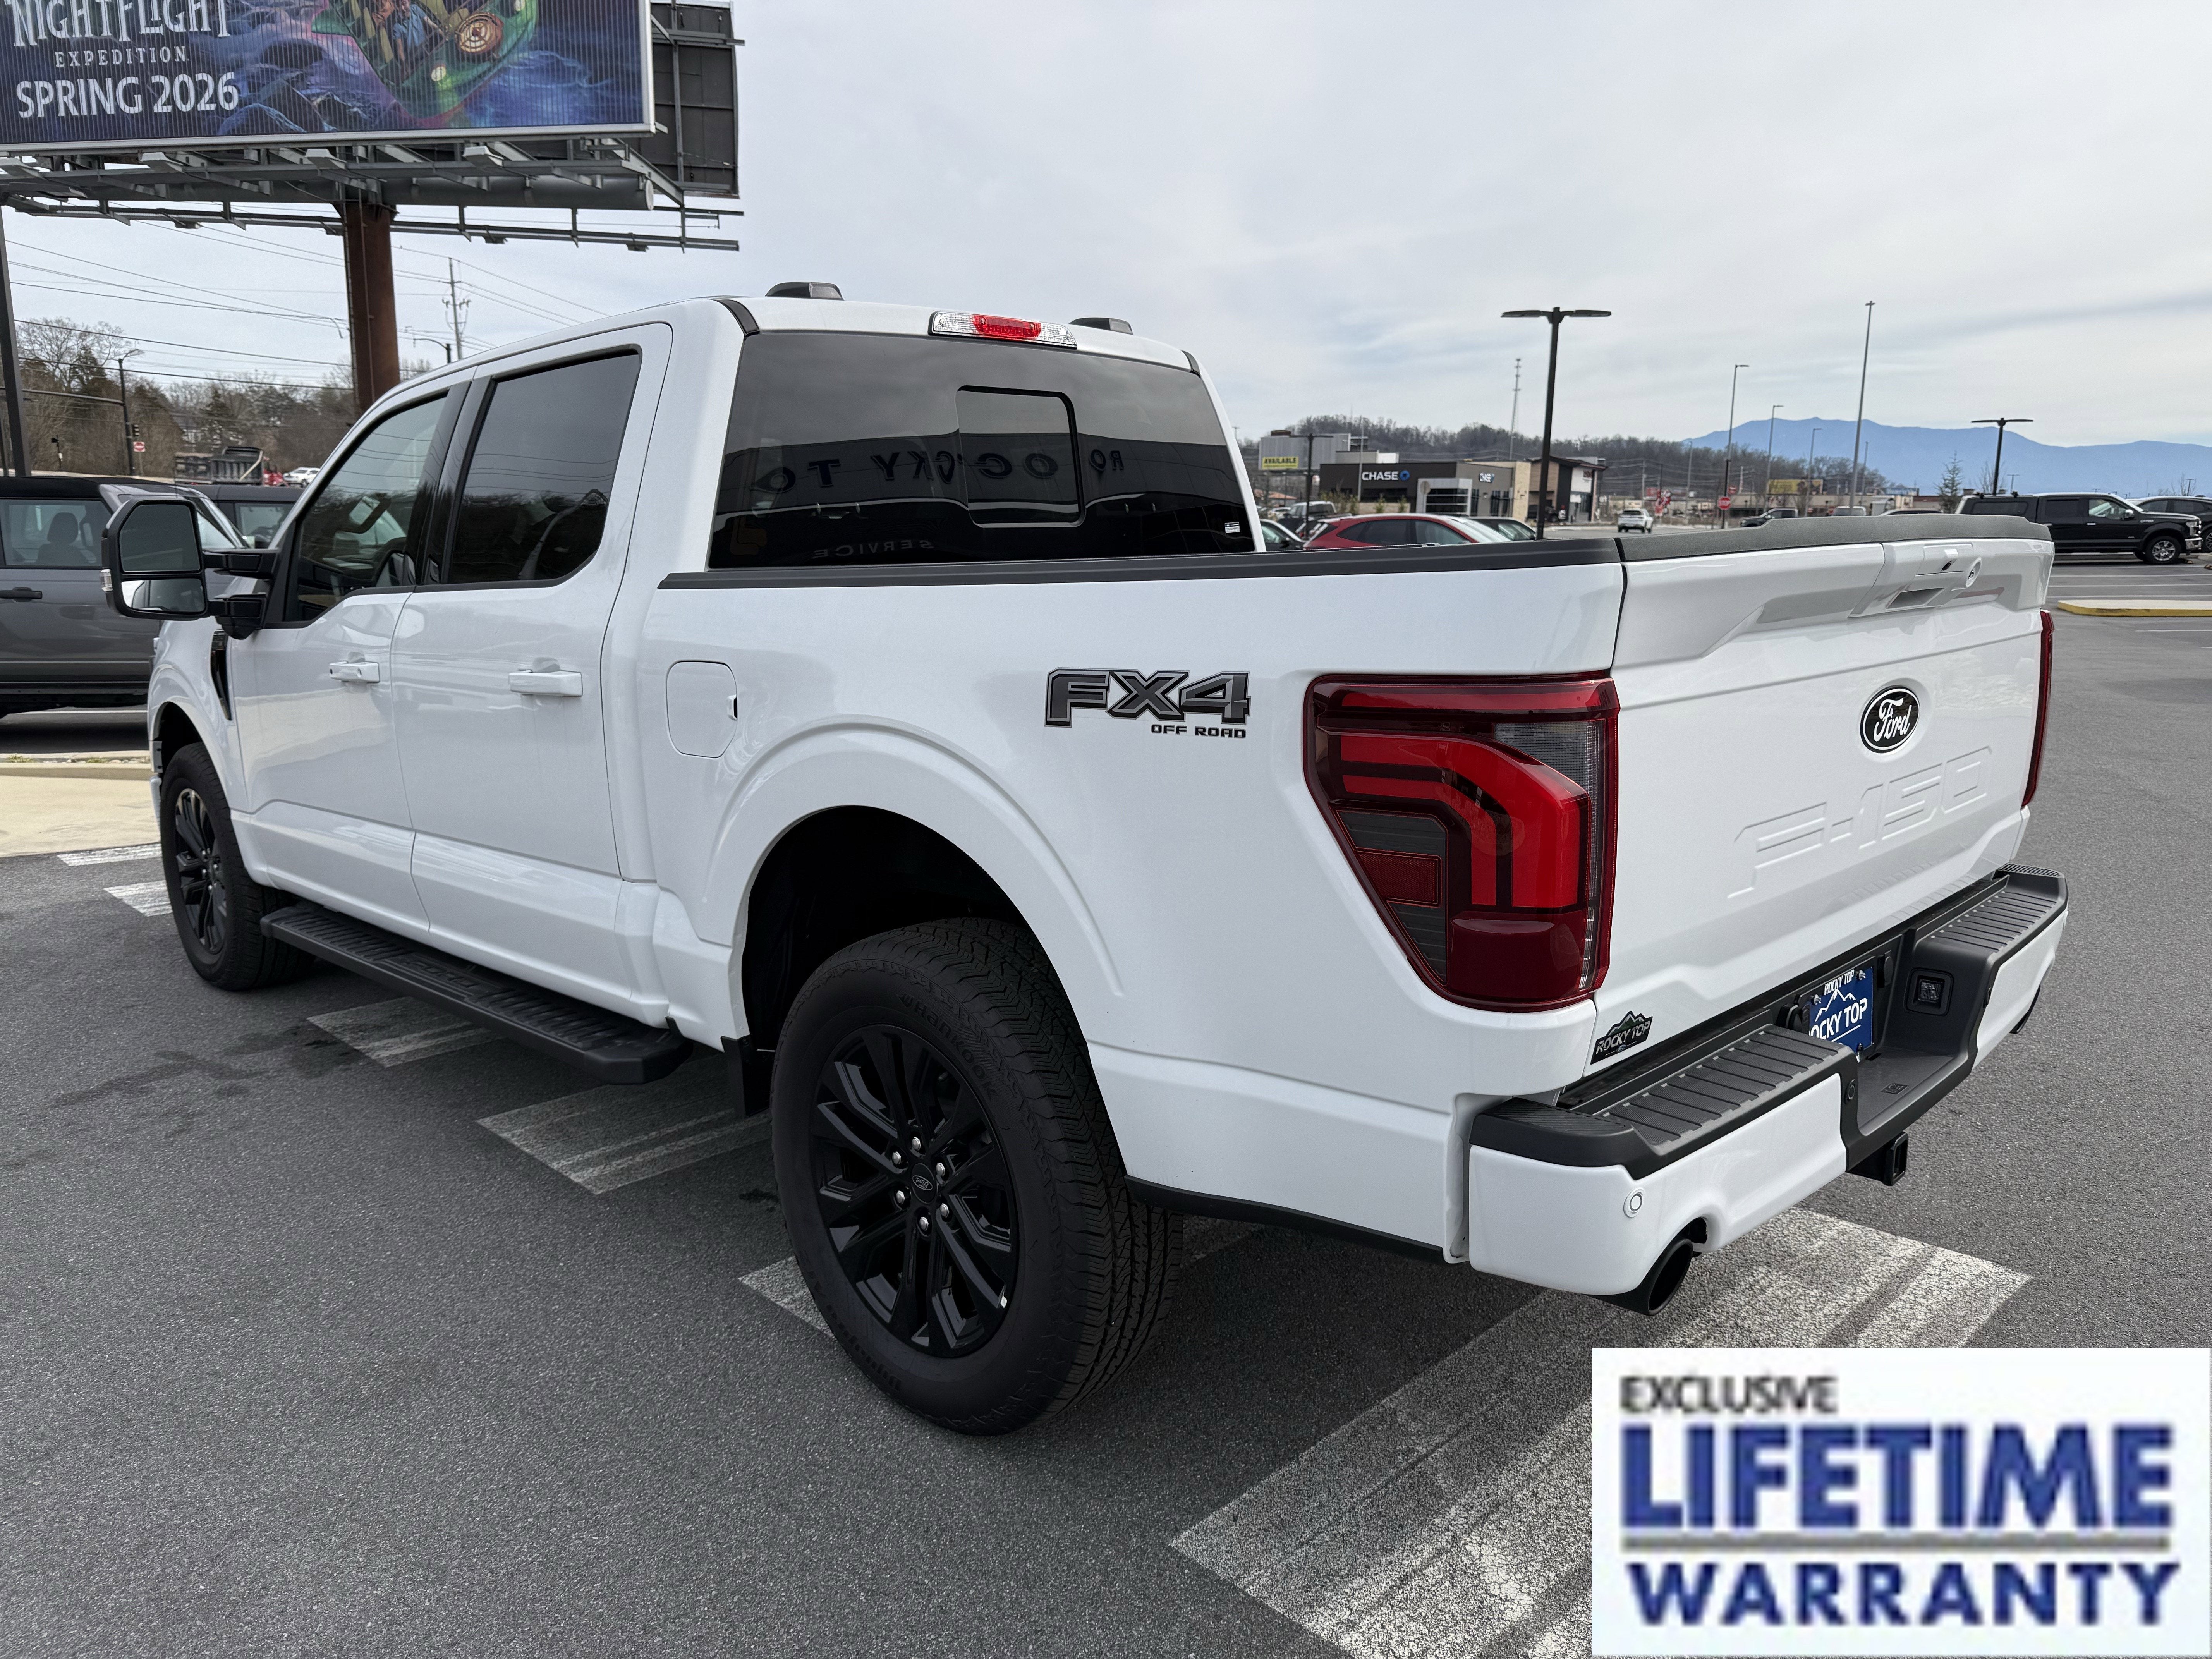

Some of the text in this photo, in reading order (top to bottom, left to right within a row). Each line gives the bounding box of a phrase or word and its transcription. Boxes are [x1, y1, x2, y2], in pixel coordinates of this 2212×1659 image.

[55, 46, 187, 67] EXPEDITION
[16, 72, 238, 118] SPRING 2026
[1362, 471, 1398, 481] CHASE
[1044, 667, 1251, 728] FX4
[1151, 724, 1247, 738] OFF ROAD
[1873, 698, 1912, 742] Ford
[1824, 969, 1855, 995] ROCKY TOP
[1808, 998, 1867, 1040] OCKY TOP
[1596, 1020, 1650, 1054] ROCKY TOP
